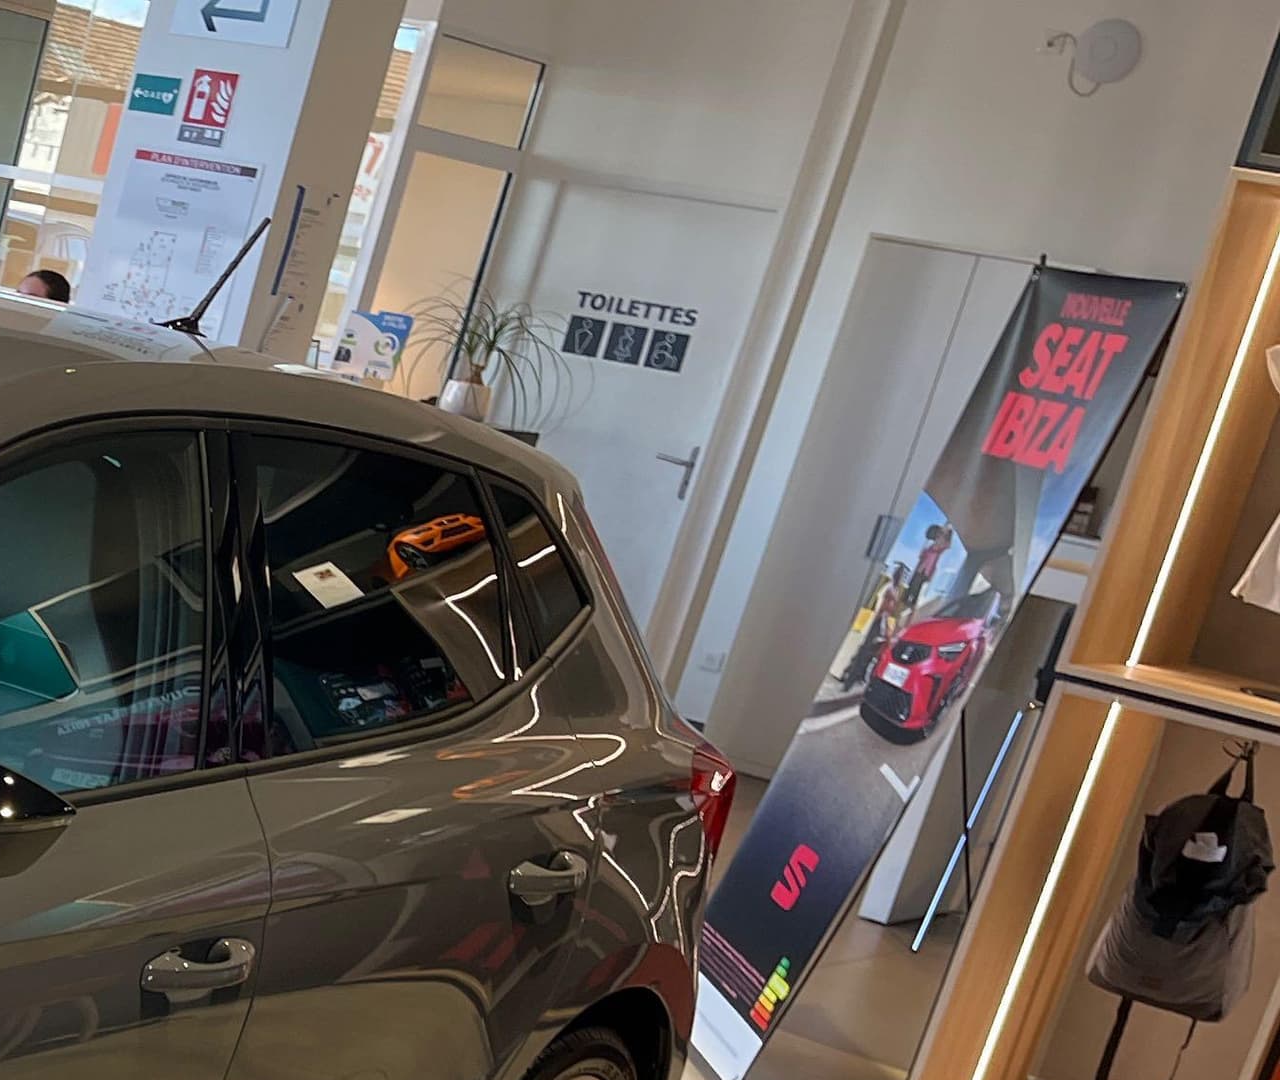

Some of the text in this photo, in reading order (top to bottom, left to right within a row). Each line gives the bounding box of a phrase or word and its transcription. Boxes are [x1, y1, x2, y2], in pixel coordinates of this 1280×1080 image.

[150, 153, 242, 175] PLAN D'INTERVENTION
[578, 290, 699, 327] TOILETTES
[1060, 292, 1133, 327] NOUVELLE
[1018, 322, 1130, 400] SEAT
[981, 391, 1086, 474] IBIZA
